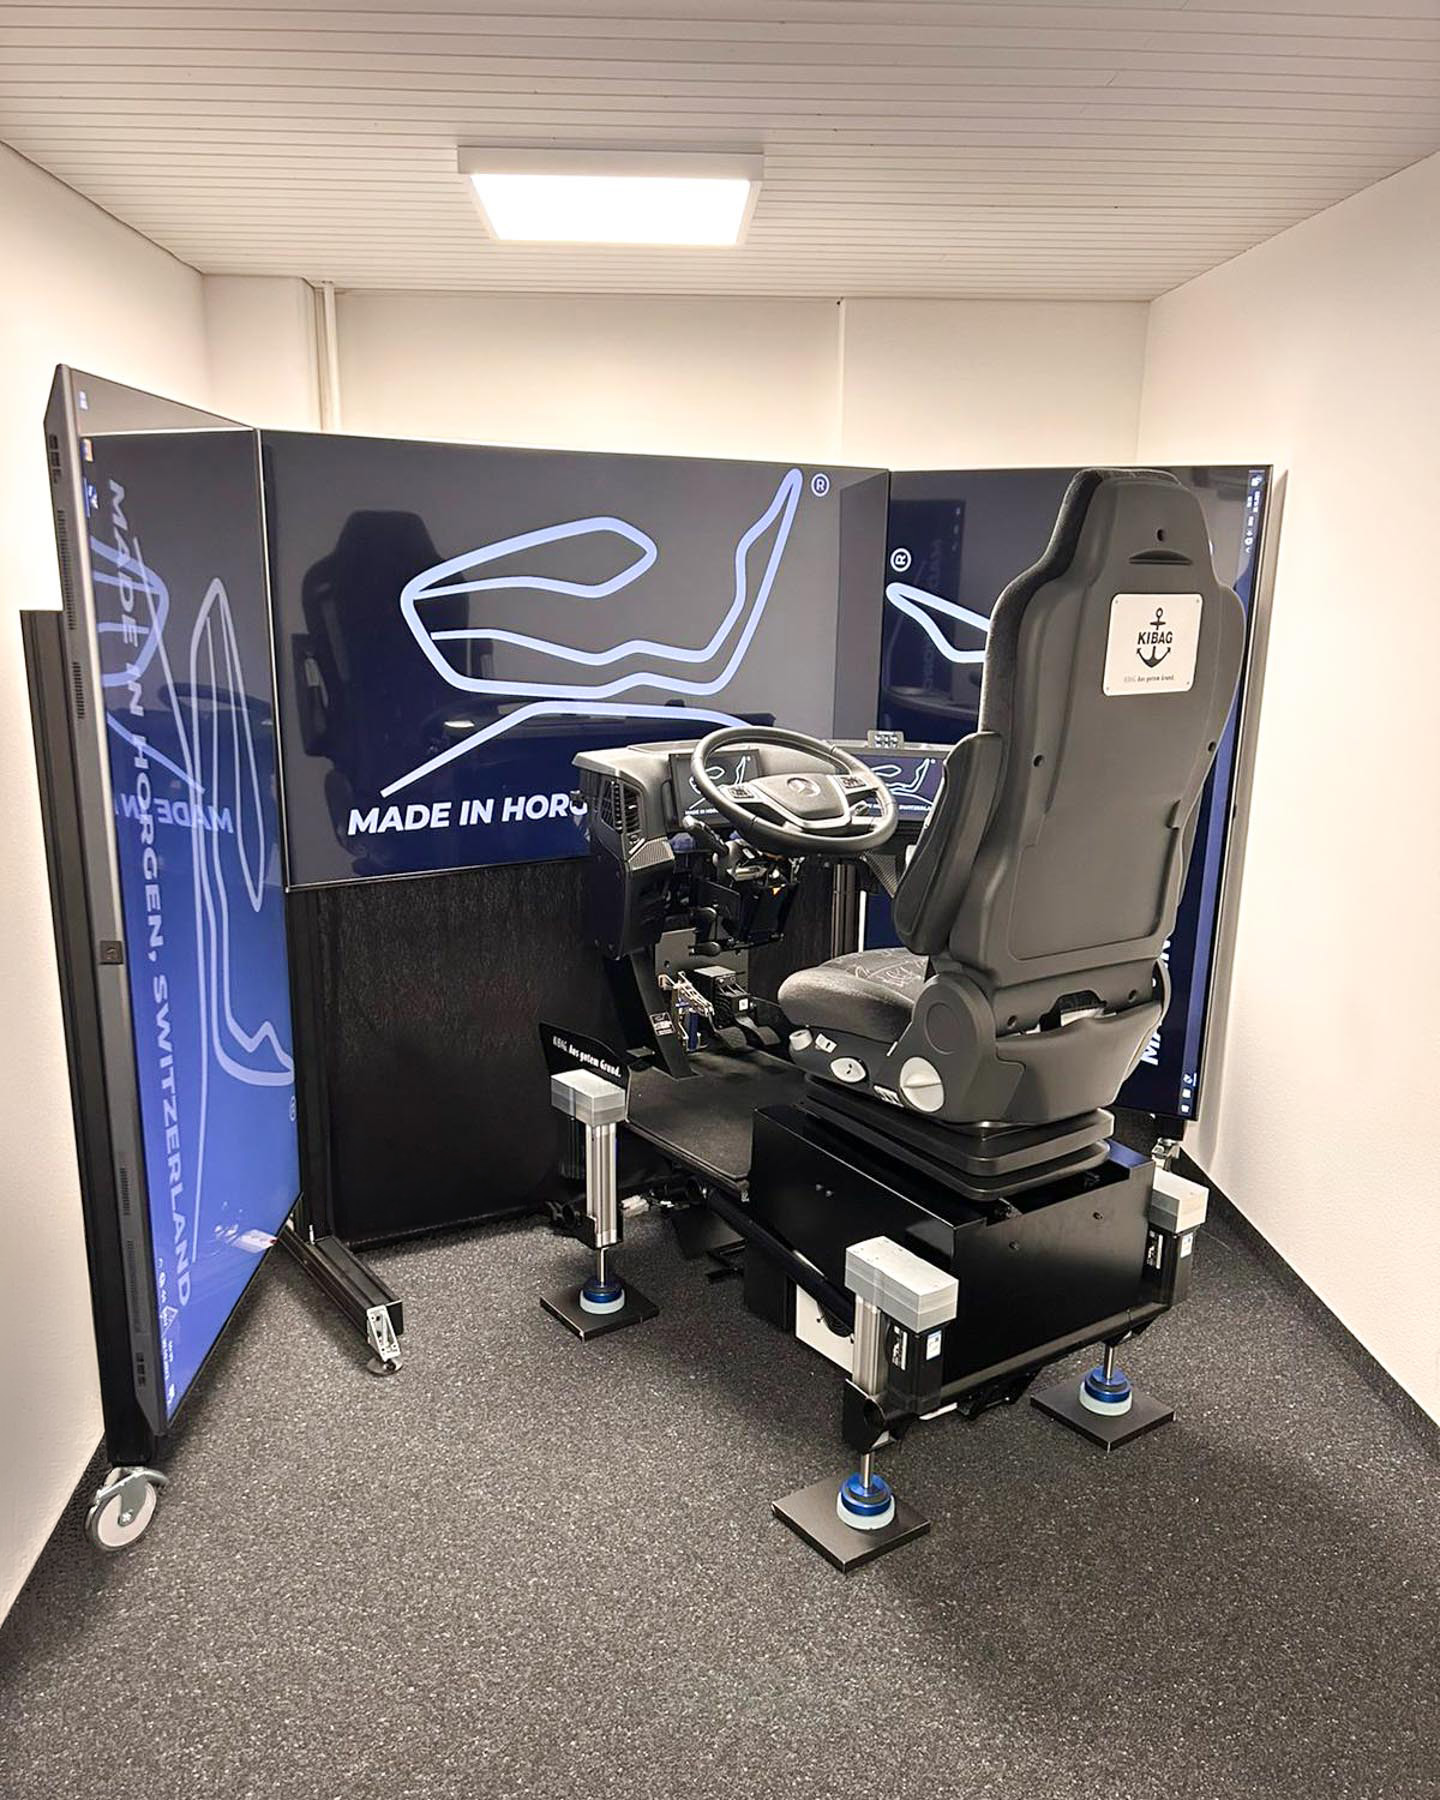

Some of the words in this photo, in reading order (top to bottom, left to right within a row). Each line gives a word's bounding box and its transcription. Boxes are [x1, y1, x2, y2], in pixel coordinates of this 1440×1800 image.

[1137, 631, 1173, 645] KIBAG
[347, 802, 452, 836] MADE
[459, 799, 495, 826] IN
[109, 480, 139, 647] MADE
[133, 733, 164, 962] HORGEN,
[153, 975, 192, 1307] SWITZERLAND
